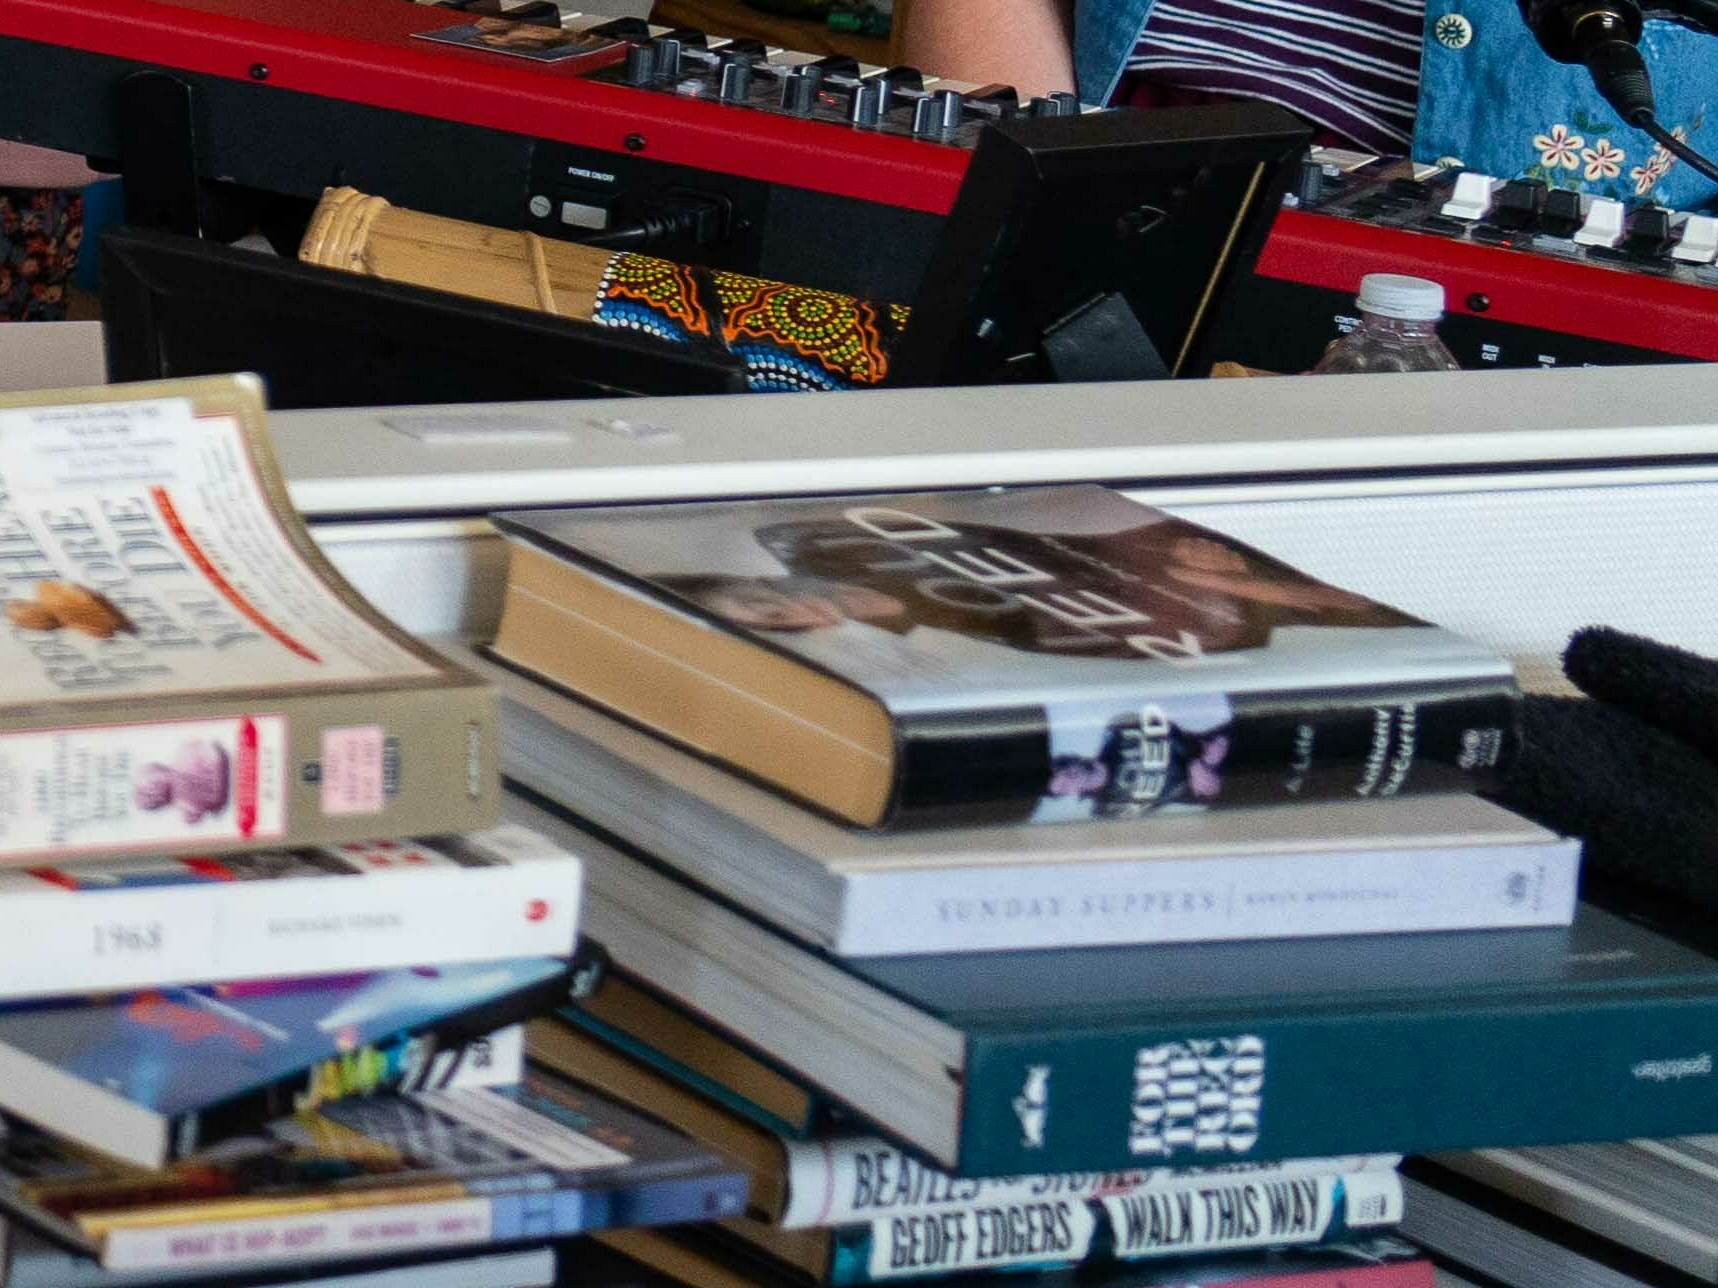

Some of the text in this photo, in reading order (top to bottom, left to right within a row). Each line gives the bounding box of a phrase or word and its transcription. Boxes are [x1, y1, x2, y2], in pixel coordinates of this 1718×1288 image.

[844, 506, 1205, 666] REED
[936, 895, 1055, 923] SUNDAY
[1083, 889, 1218, 919] SUPPERS
[91, 922, 164, 958] 1968
[890, 1176, 1320, 1269] GEOFF EDGERS WALK THIS WAY
